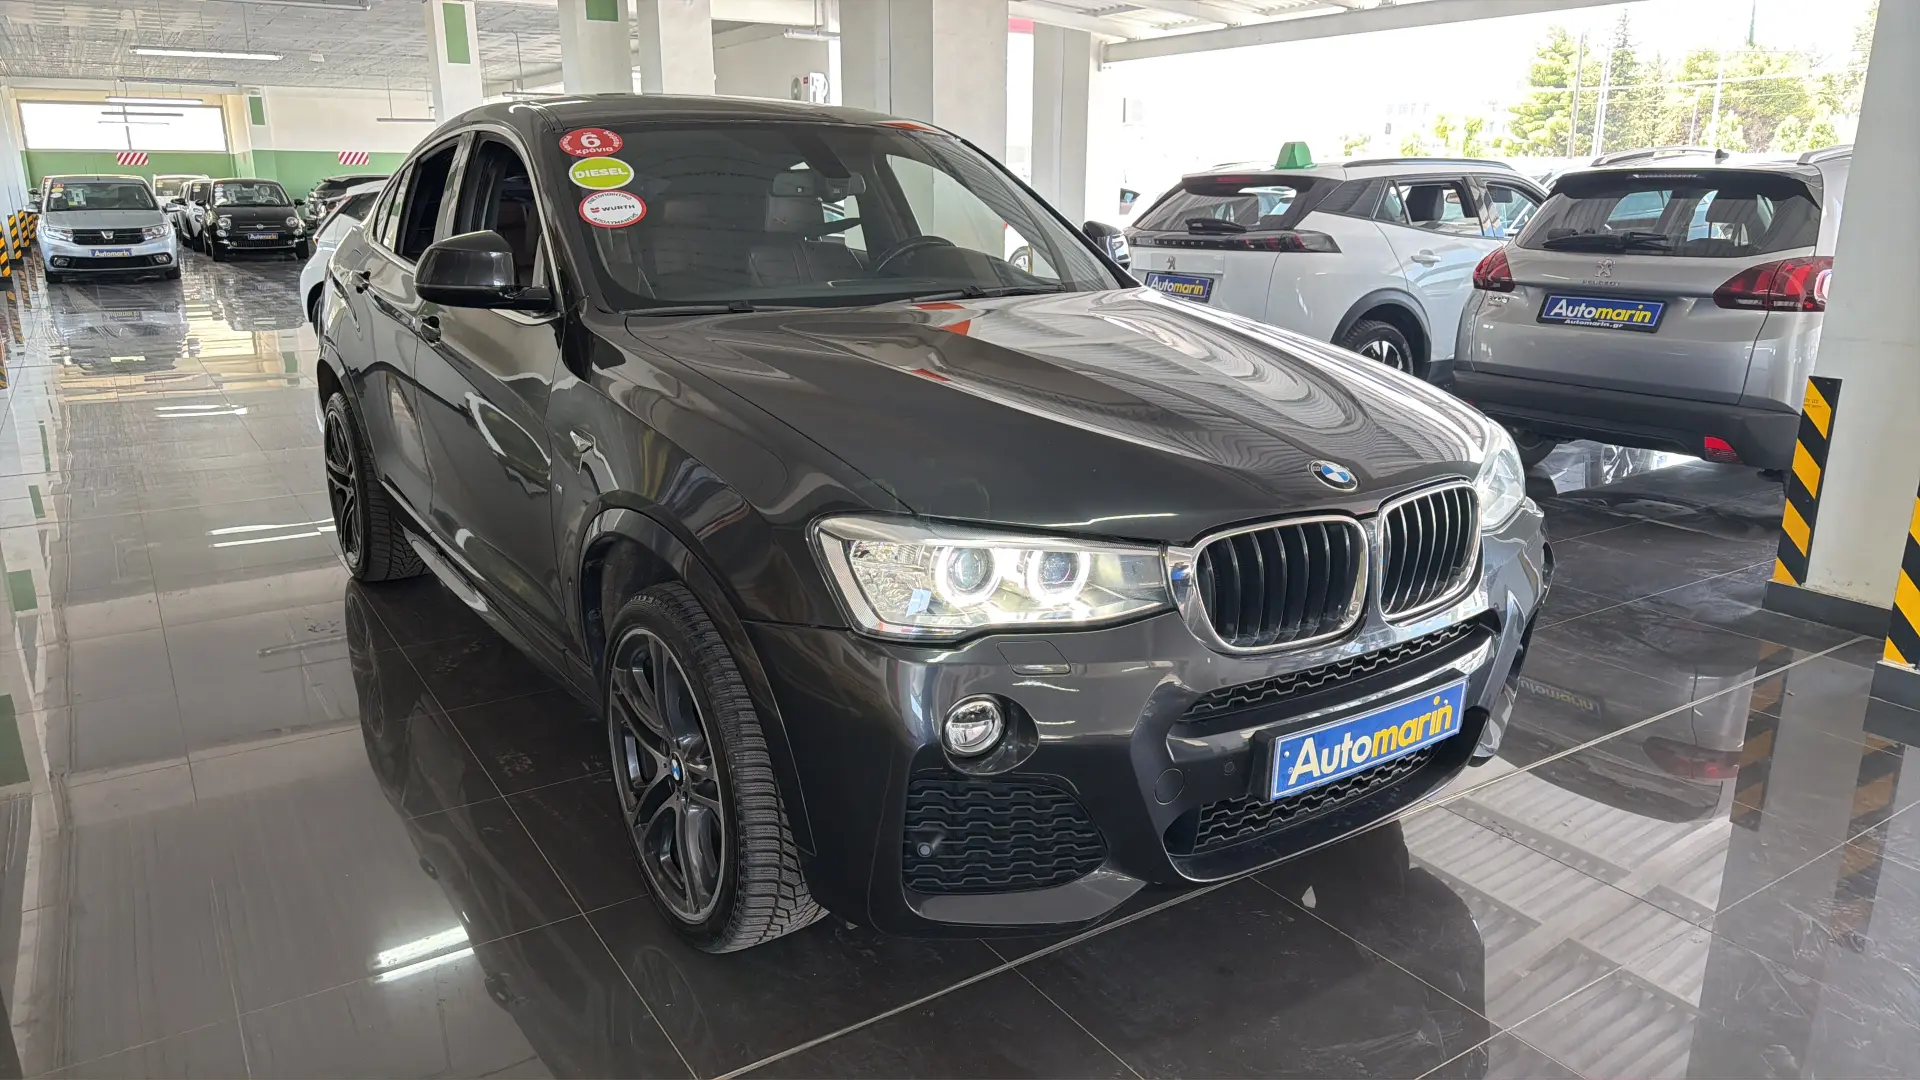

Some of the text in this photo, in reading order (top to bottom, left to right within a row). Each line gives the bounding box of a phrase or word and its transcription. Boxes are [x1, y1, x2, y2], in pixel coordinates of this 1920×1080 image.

[580, 134, 601, 148] 6
[574, 167, 628, 179] DIESEL
[1150, 275, 1204, 296] Automarin
[1550, 298, 1652, 323] Automarin
[1564, 318, 1624, 329] Automarin.gr
[1287, 695, 1453, 786] Automarin
